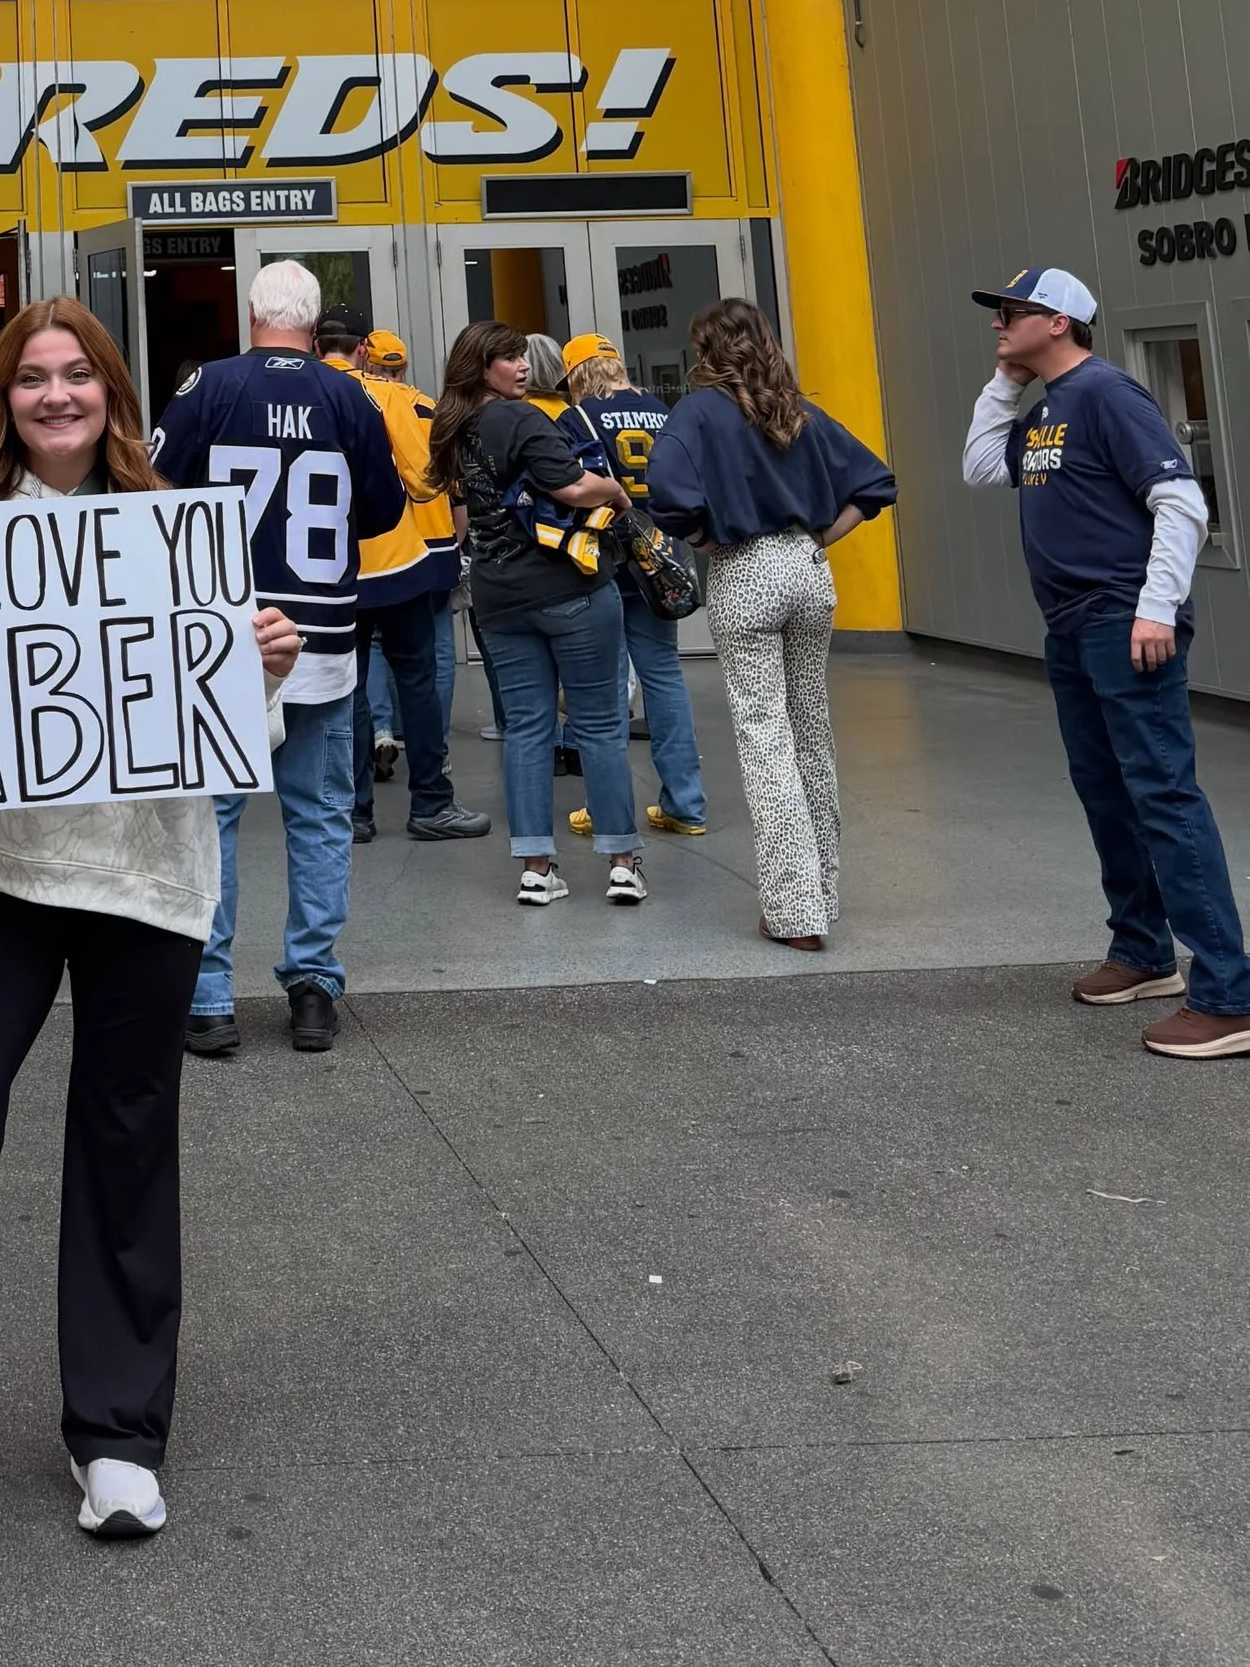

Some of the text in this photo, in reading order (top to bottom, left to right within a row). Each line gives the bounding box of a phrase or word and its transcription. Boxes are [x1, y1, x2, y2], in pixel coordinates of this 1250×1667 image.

[148, 189, 316, 214] ALL BAGS ENTRY
[166, 236, 222, 254] ENTRY
[1137, 217, 1237, 266] SOBRO
[267, 403, 312, 440] HAK
[208, 445, 352, 584] 78
[151, 499, 251, 608] YOU
